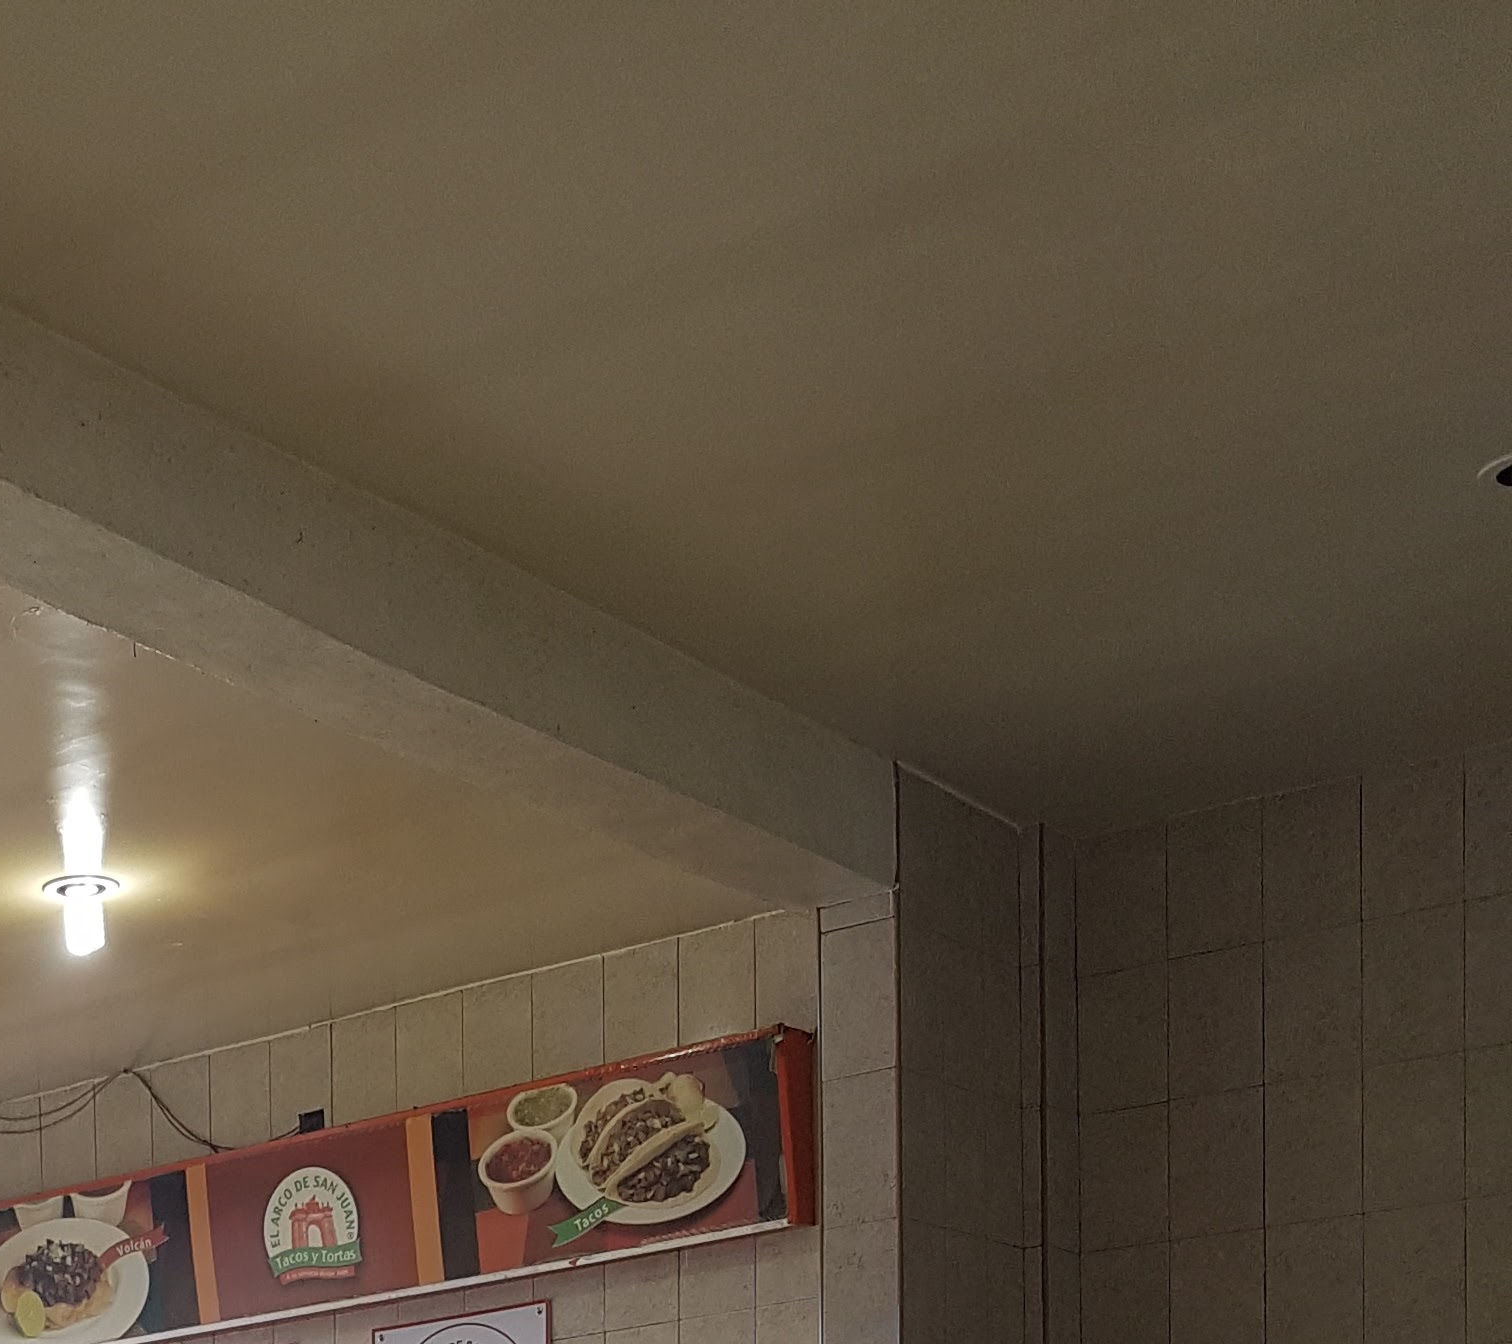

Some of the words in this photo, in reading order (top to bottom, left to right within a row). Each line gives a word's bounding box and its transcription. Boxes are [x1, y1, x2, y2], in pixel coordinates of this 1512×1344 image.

[294, 1176, 310, 1192] DE
[313, 1175, 339, 1195] SAN
[271, 1188, 293, 1227] ARCO
[336, 1192, 355, 1230] JUAN
[573, 1202, 609, 1233] Tacos
[116, 1237, 152, 1256] Volcán
[270, 1232, 280, 1248] EL
[276, 1251, 308, 1269] Tacos
[312, 1253, 319, 1264] y
[321, 1249, 356, 1263] Tortas
